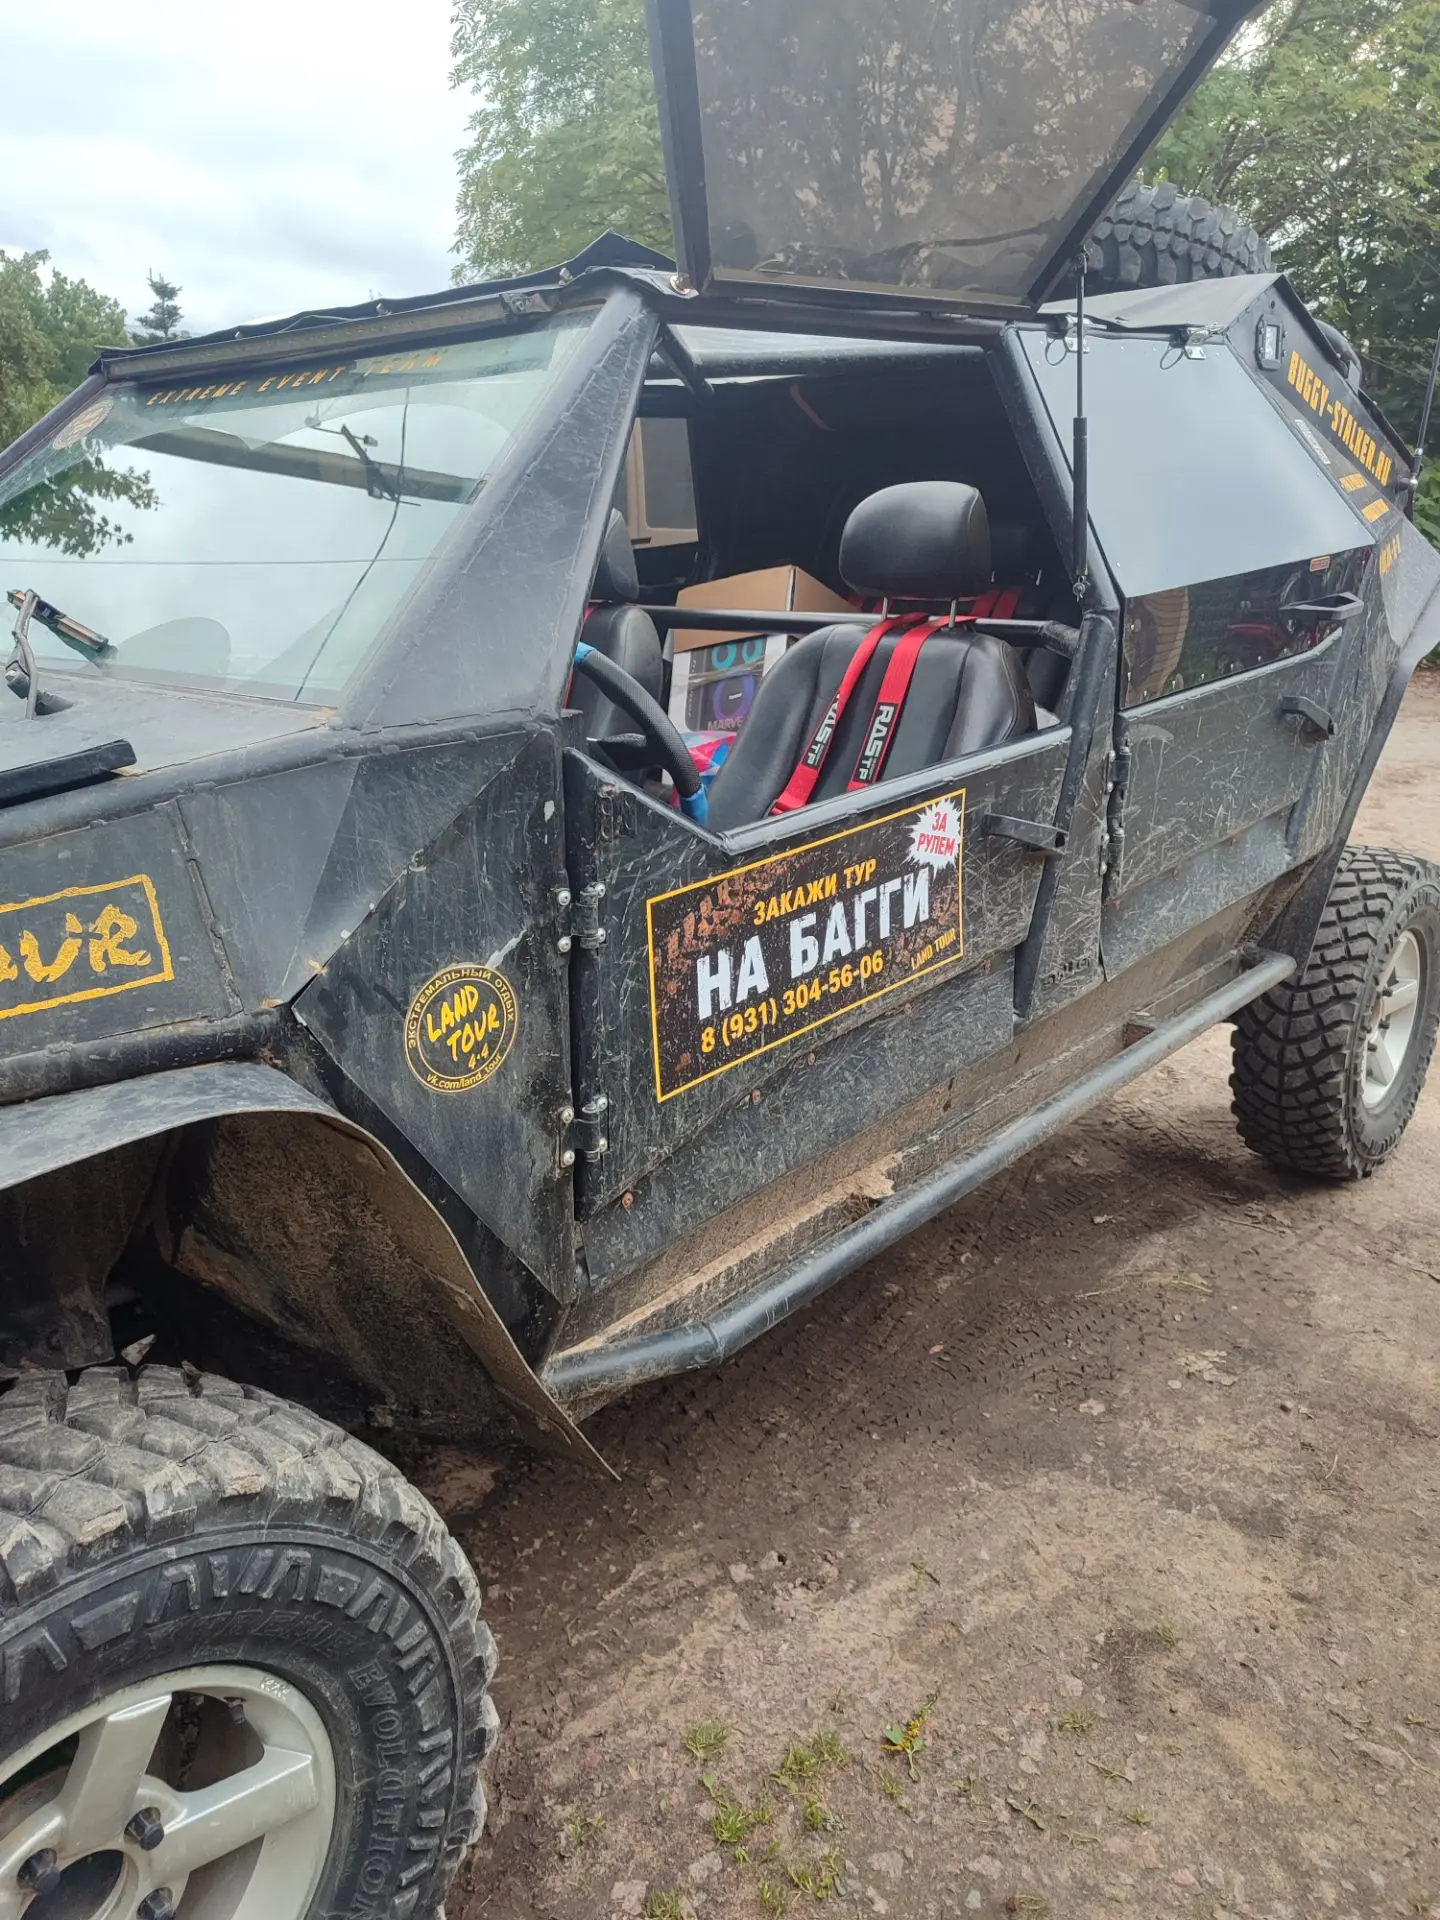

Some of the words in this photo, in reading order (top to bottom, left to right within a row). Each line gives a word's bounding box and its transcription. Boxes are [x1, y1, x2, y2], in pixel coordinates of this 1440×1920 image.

[146, 380, 249, 406] EXTREME
[257, 366, 346, 393] EVENT
[807, 692, 840, 766] ASTP
[916, 832, 956, 857] РУЛЕМ
[931, 811, 948, 832] ЗА
[753, 873, 838, 926] ЗАКАЖИ
[843, 858, 877, 889] ТУР
[696, 935, 770, 1020] НА
[789, 867, 929, 979] БАГГИ
[911, 944, 934, 970] LAND
[934, 927, 957, 952] TOUR
[408, 968, 492, 1049] ЭКСТРЕМАЛЬНЫЙ
[494, 979, 515, 1021] ОТДЫХ
[426, 985, 479, 1043] LAND
[701, 1026, 716, 1053] 8
[722, 997, 779, 1047] (931)
[782, 949, 884, 1015] 304-56-06
[446, 1003, 500, 1062] TOUR
